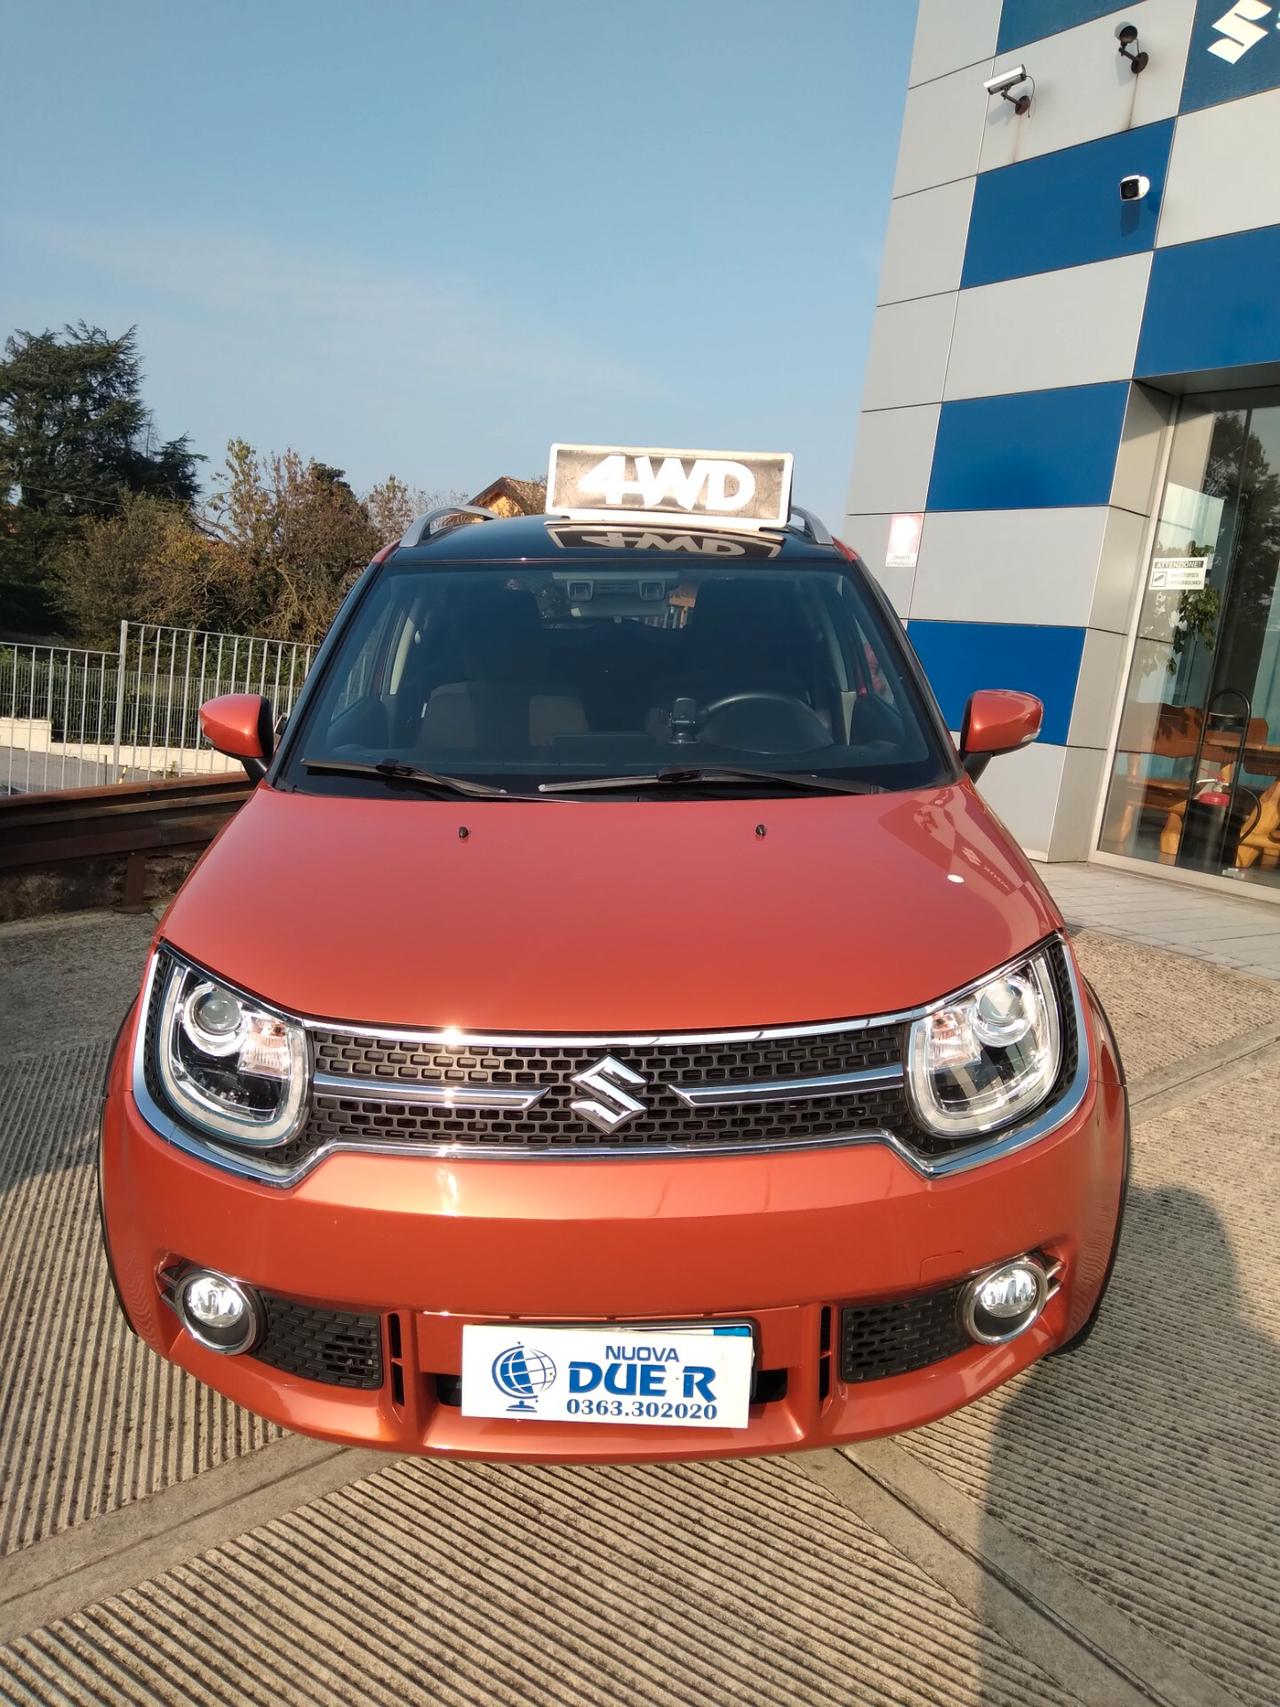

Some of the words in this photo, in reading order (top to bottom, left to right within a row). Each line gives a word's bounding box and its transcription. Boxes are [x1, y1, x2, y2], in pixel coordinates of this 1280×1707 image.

[578, 456, 756, 511] 4WD
[606, 1346, 679, 1362] NUOVA
[568, 1361, 667, 1397] DUE
[682, 1366, 718, 1403] R
[567, 1399, 718, 1419] 0363.302020
